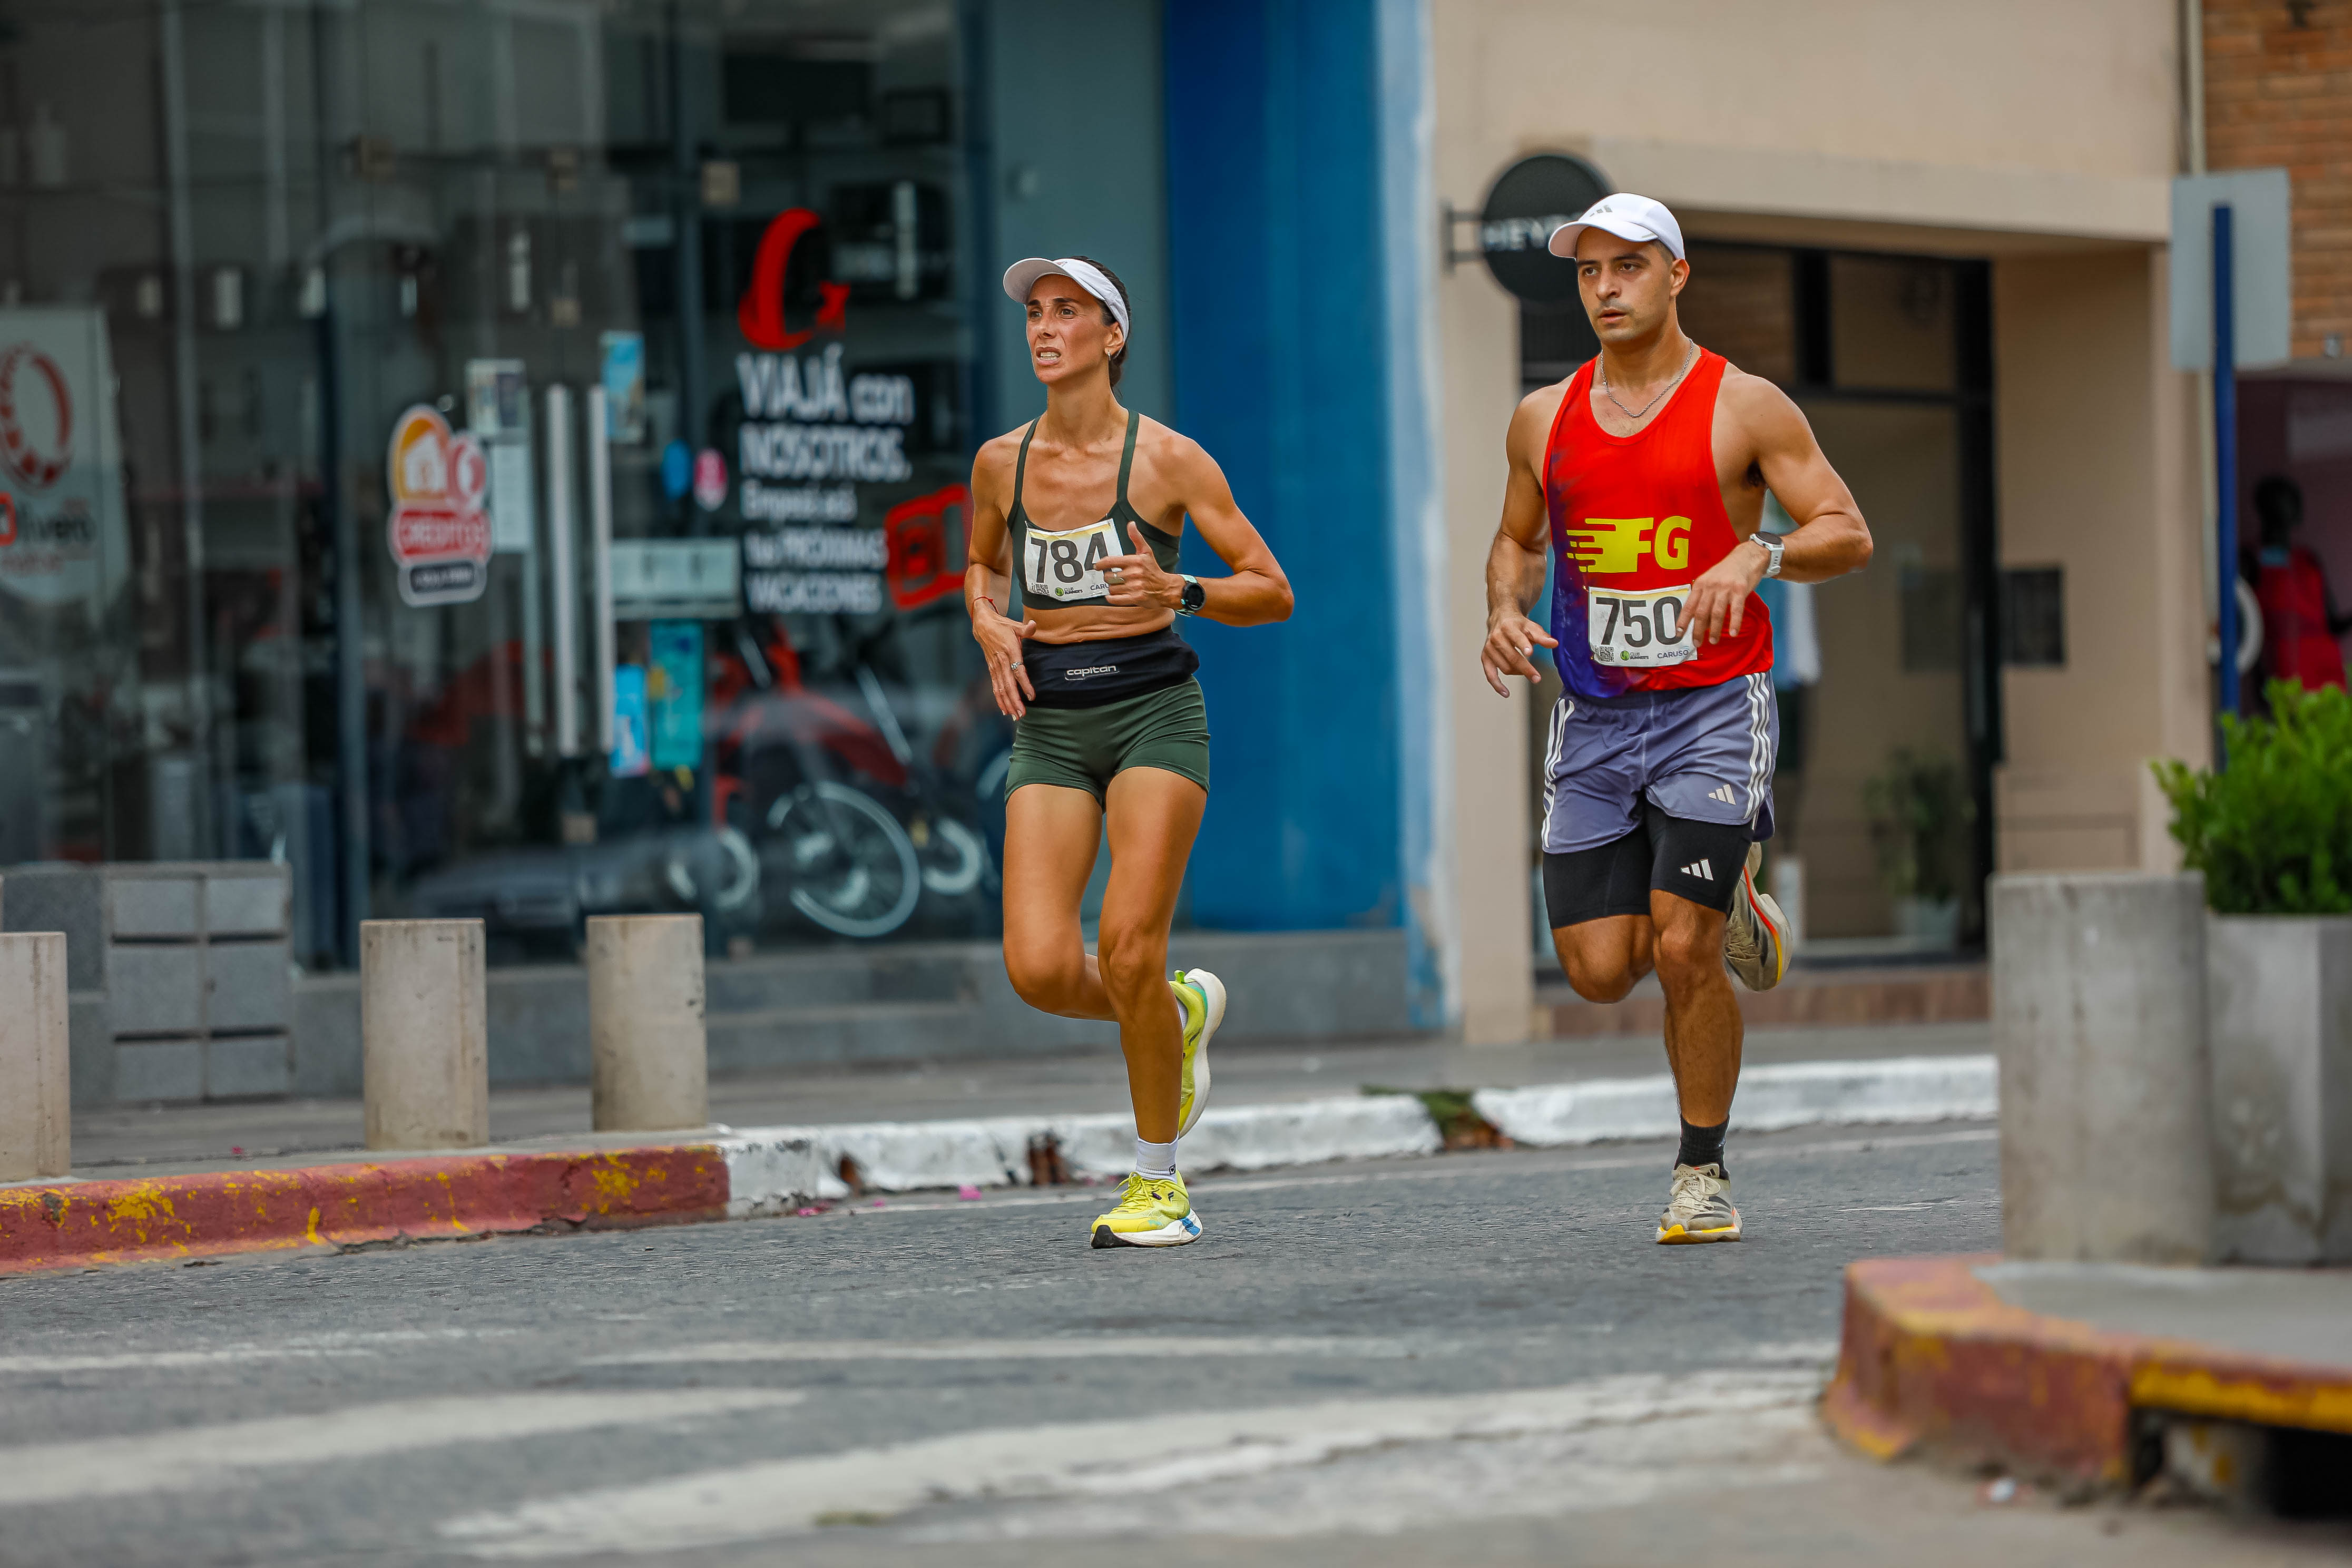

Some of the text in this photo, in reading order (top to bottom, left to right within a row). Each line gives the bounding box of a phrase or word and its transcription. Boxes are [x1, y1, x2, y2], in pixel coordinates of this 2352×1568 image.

[738, 344, 913, 423] VIAJÁ con
[741, 424, 911, 479] NOSOTROS.
[1031, 531, 1110, 584] 784
[1566, 515, 1692, 573] FG
[1595, 596, 1683, 648] 750
[1657, 649, 1689, 659] CARUSO
